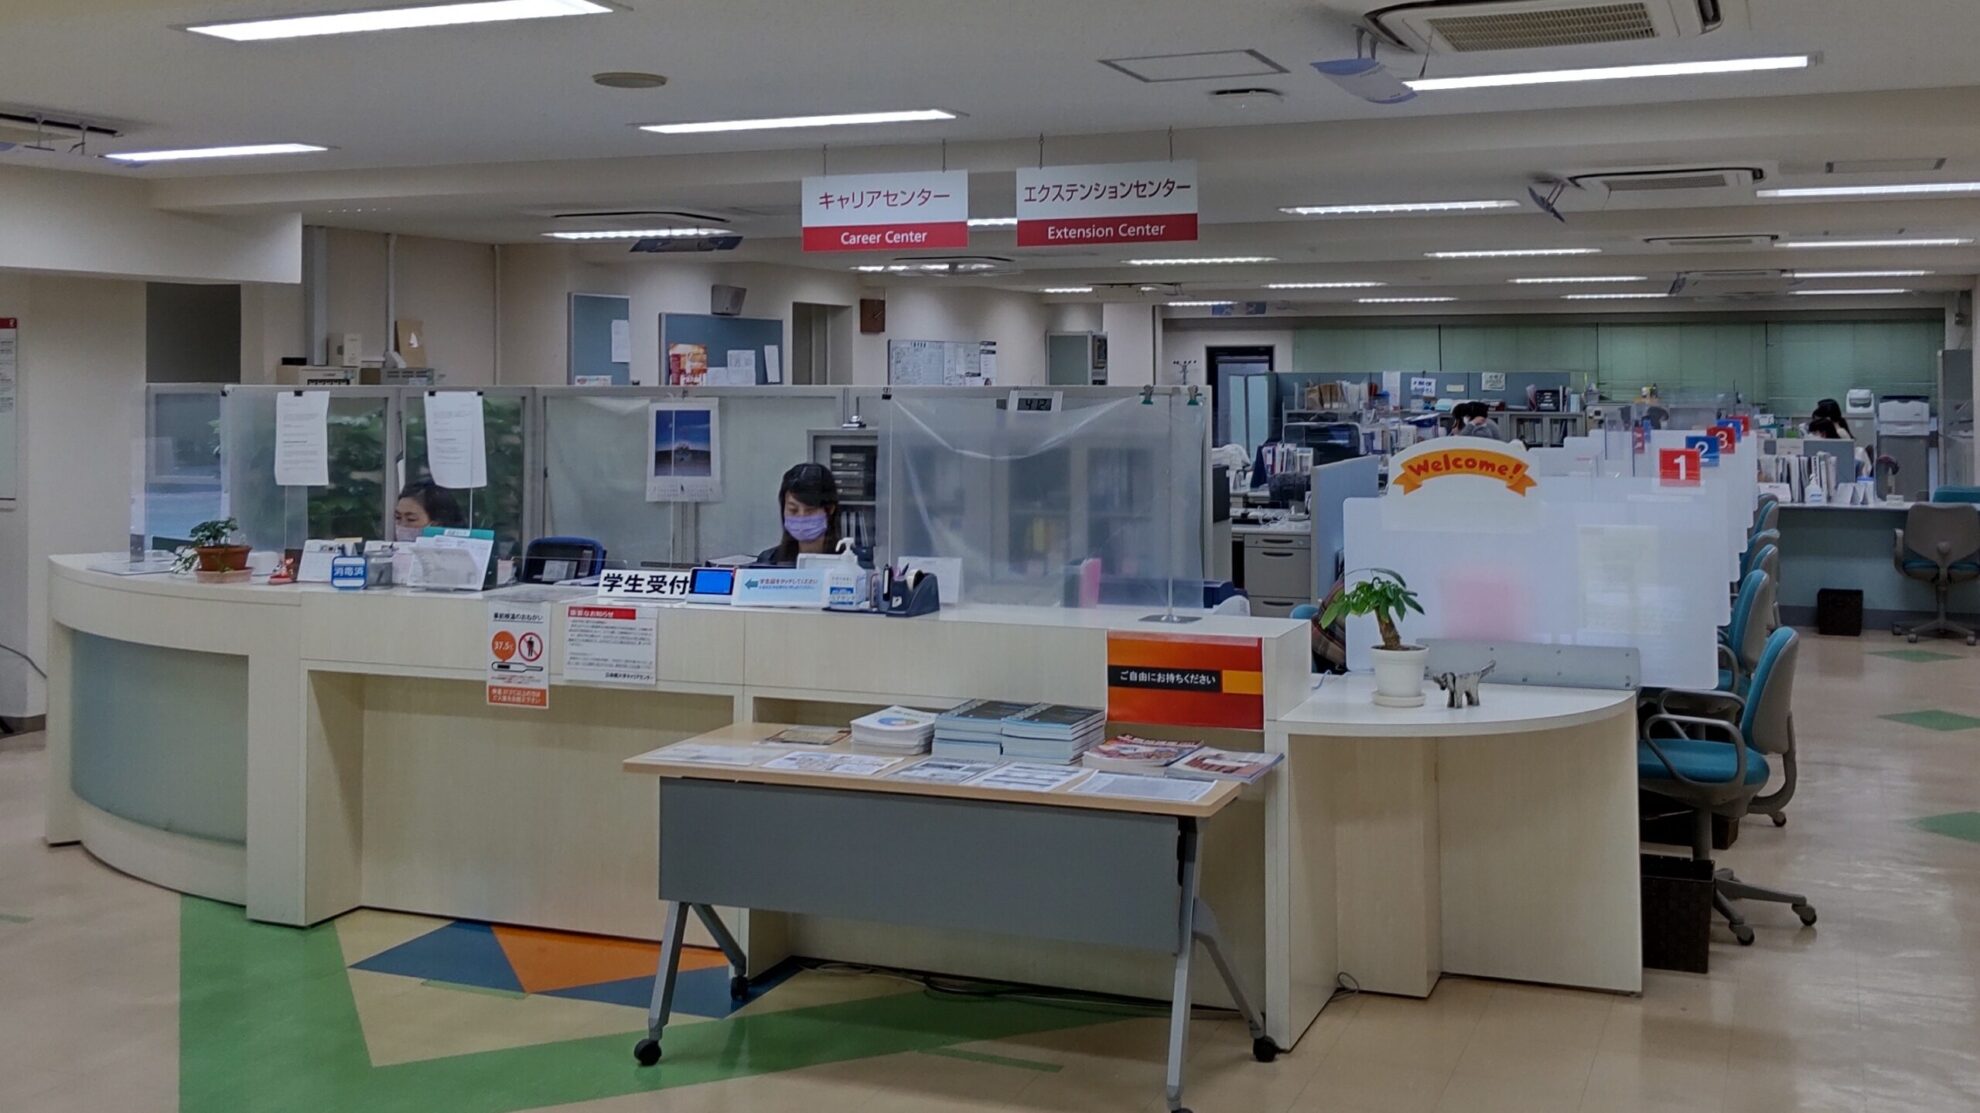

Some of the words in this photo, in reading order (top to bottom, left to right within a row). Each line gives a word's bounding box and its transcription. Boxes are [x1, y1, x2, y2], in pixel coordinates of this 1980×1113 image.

[818, 188, 951, 210] キャリアセンター
[1024, 178, 1192, 202] エクステンションセンター
[840, 232, 883, 246] Career
[886, 229, 928, 245] Center
[1047, 222, 1115, 240] Extension
[1117, 222, 1166, 238] Center
[1694, 441, 1710, 463] 2
[1408, 453, 1523, 480] Welcome!
[1673, 454, 1687, 481] 1
[602, 572, 690, 596] 学生受付
[1119, 670, 1216, 685] ご自由にお持ちください
